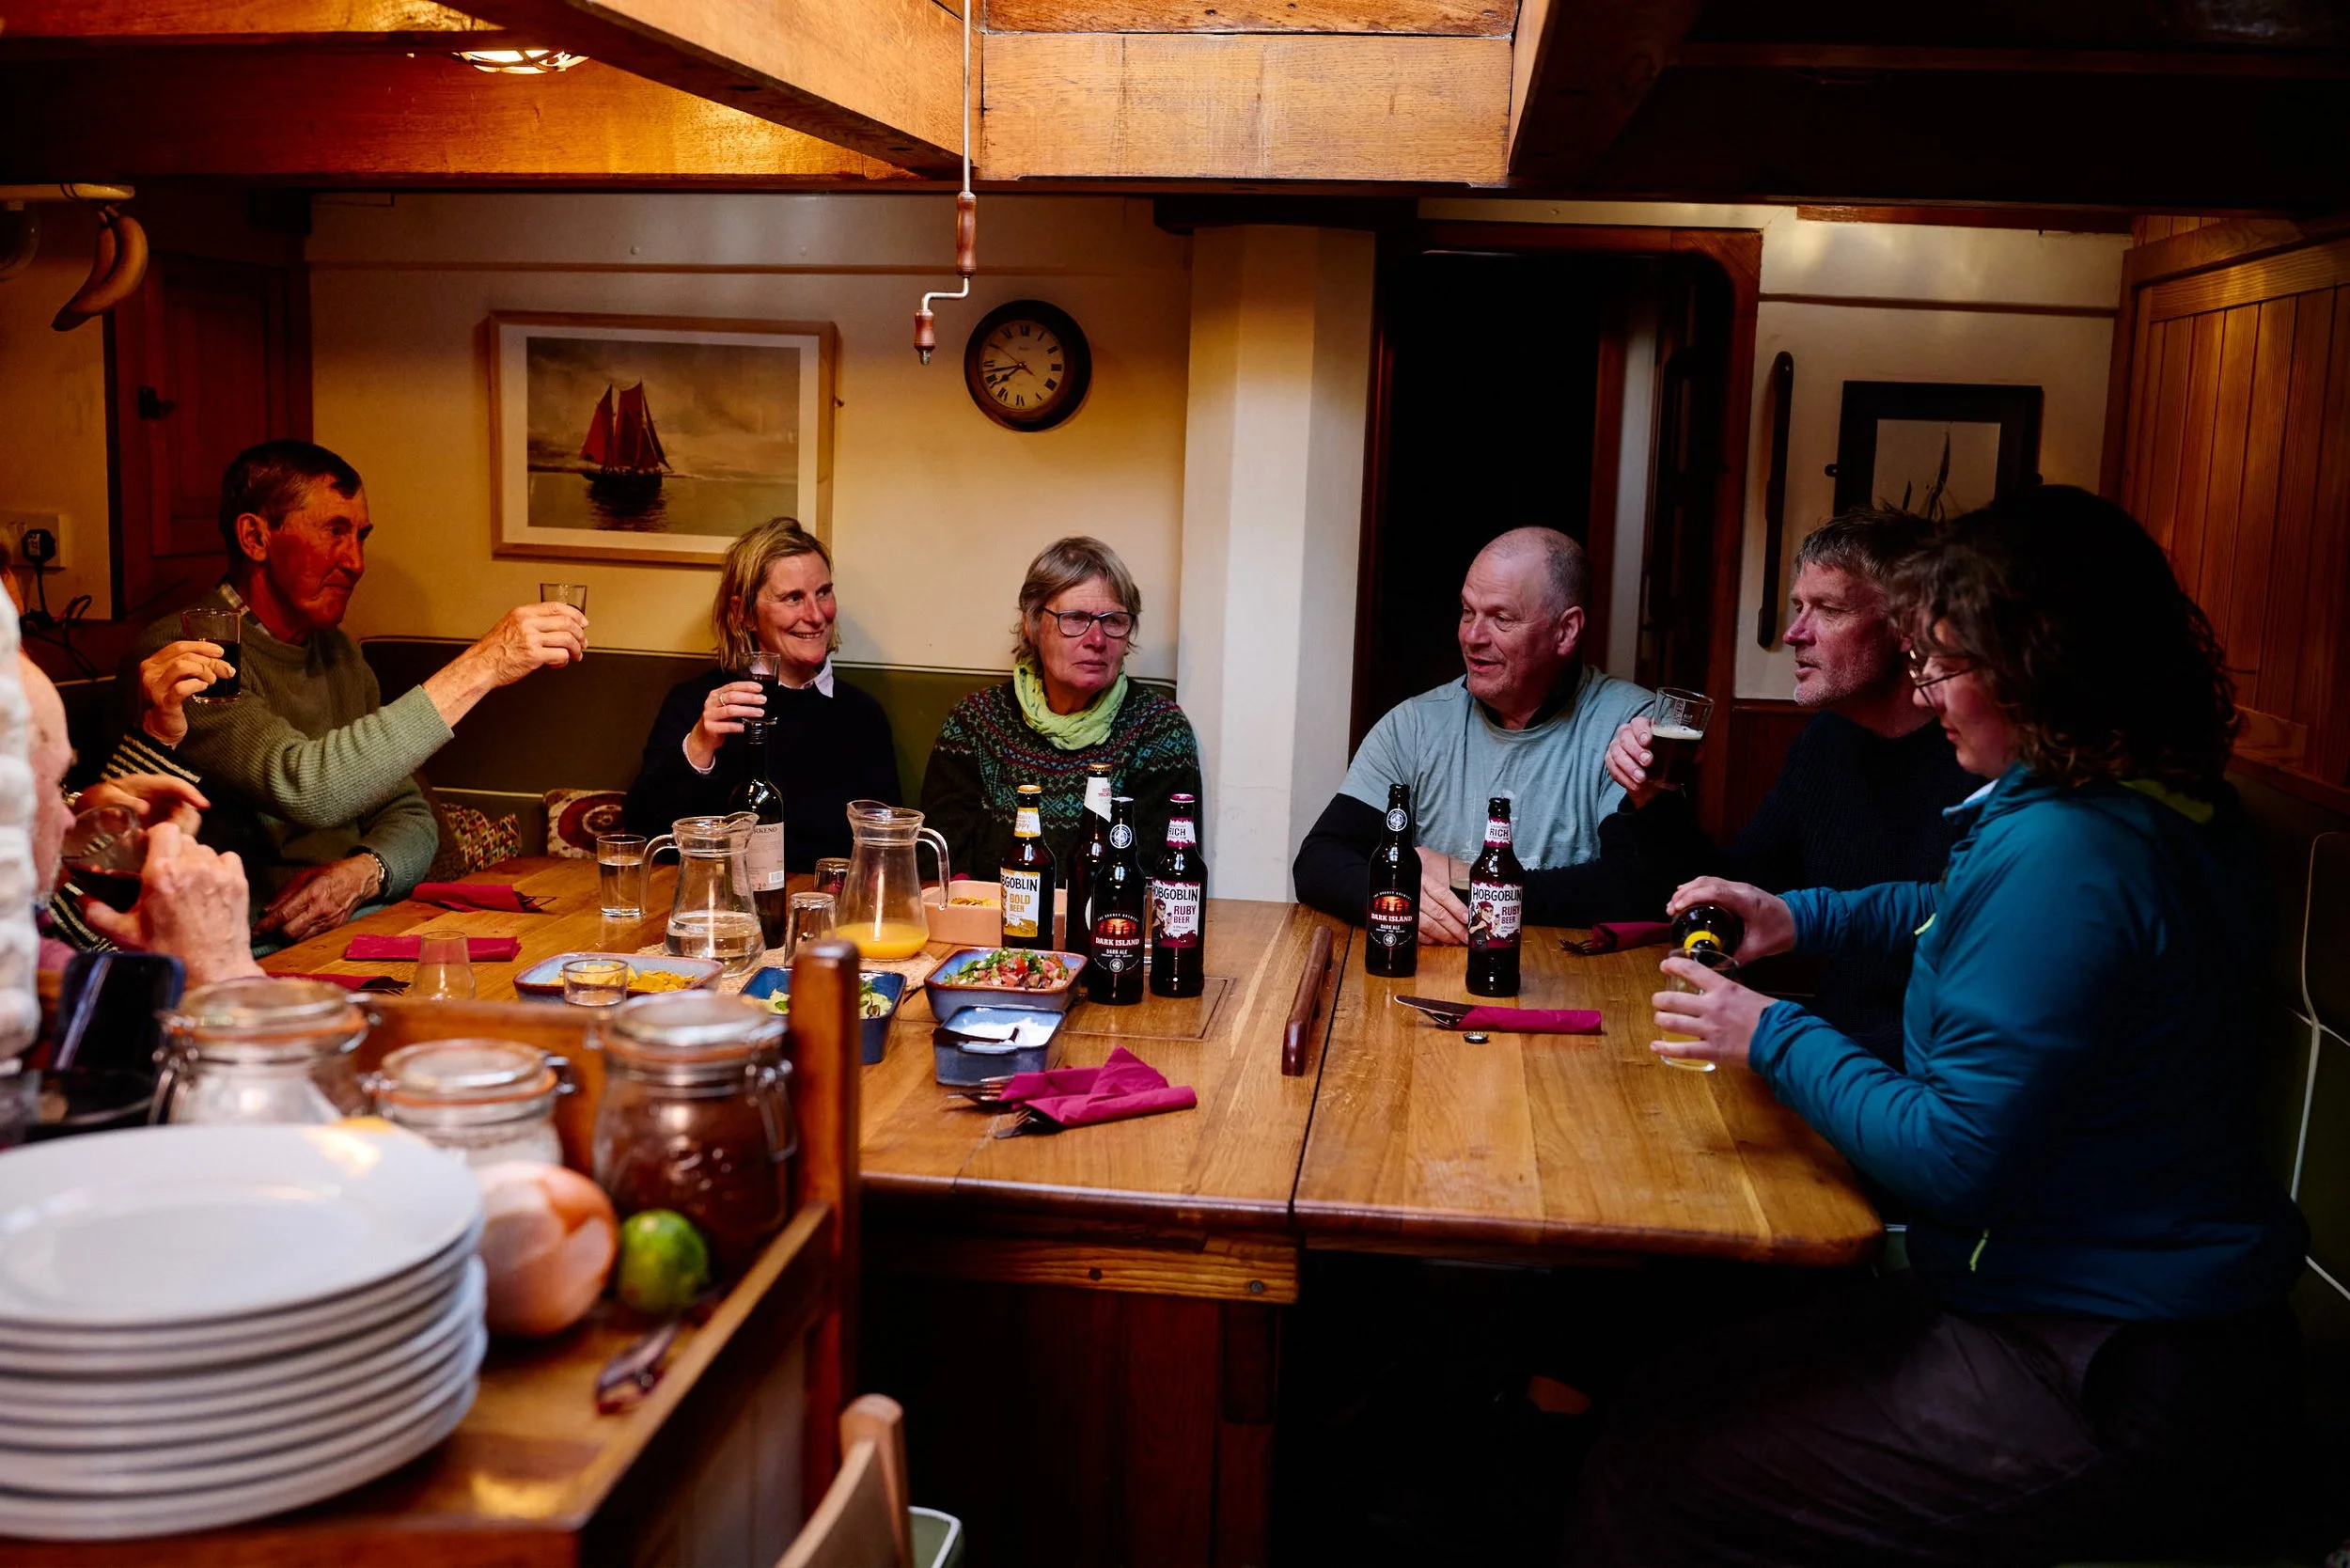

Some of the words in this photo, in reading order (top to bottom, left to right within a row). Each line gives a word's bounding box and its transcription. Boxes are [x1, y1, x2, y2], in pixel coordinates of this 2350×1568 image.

[1168, 827, 1186, 837] RICH
[1489, 828, 1509, 838] RICH
[1000, 875, 1038, 892] BGOBLIN
[1009, 893, 1030, 904] GOLD
[1472, 886, 1522, 902] HOBGOBLIN
[1009, 904, 1025, 913] BEER
[1173, 905, 1197, 916] RUBY
[1501, 906, 1521, 916] RUBY
[1173, 915, 1190, 923] BEER
[1371, 913, 1388, 921] DARK
[1501, 916, 1516, 924] BEER
[1095, 936, 1114, 946] DARK
[1115, 938, 1140, 947] ISLAND
